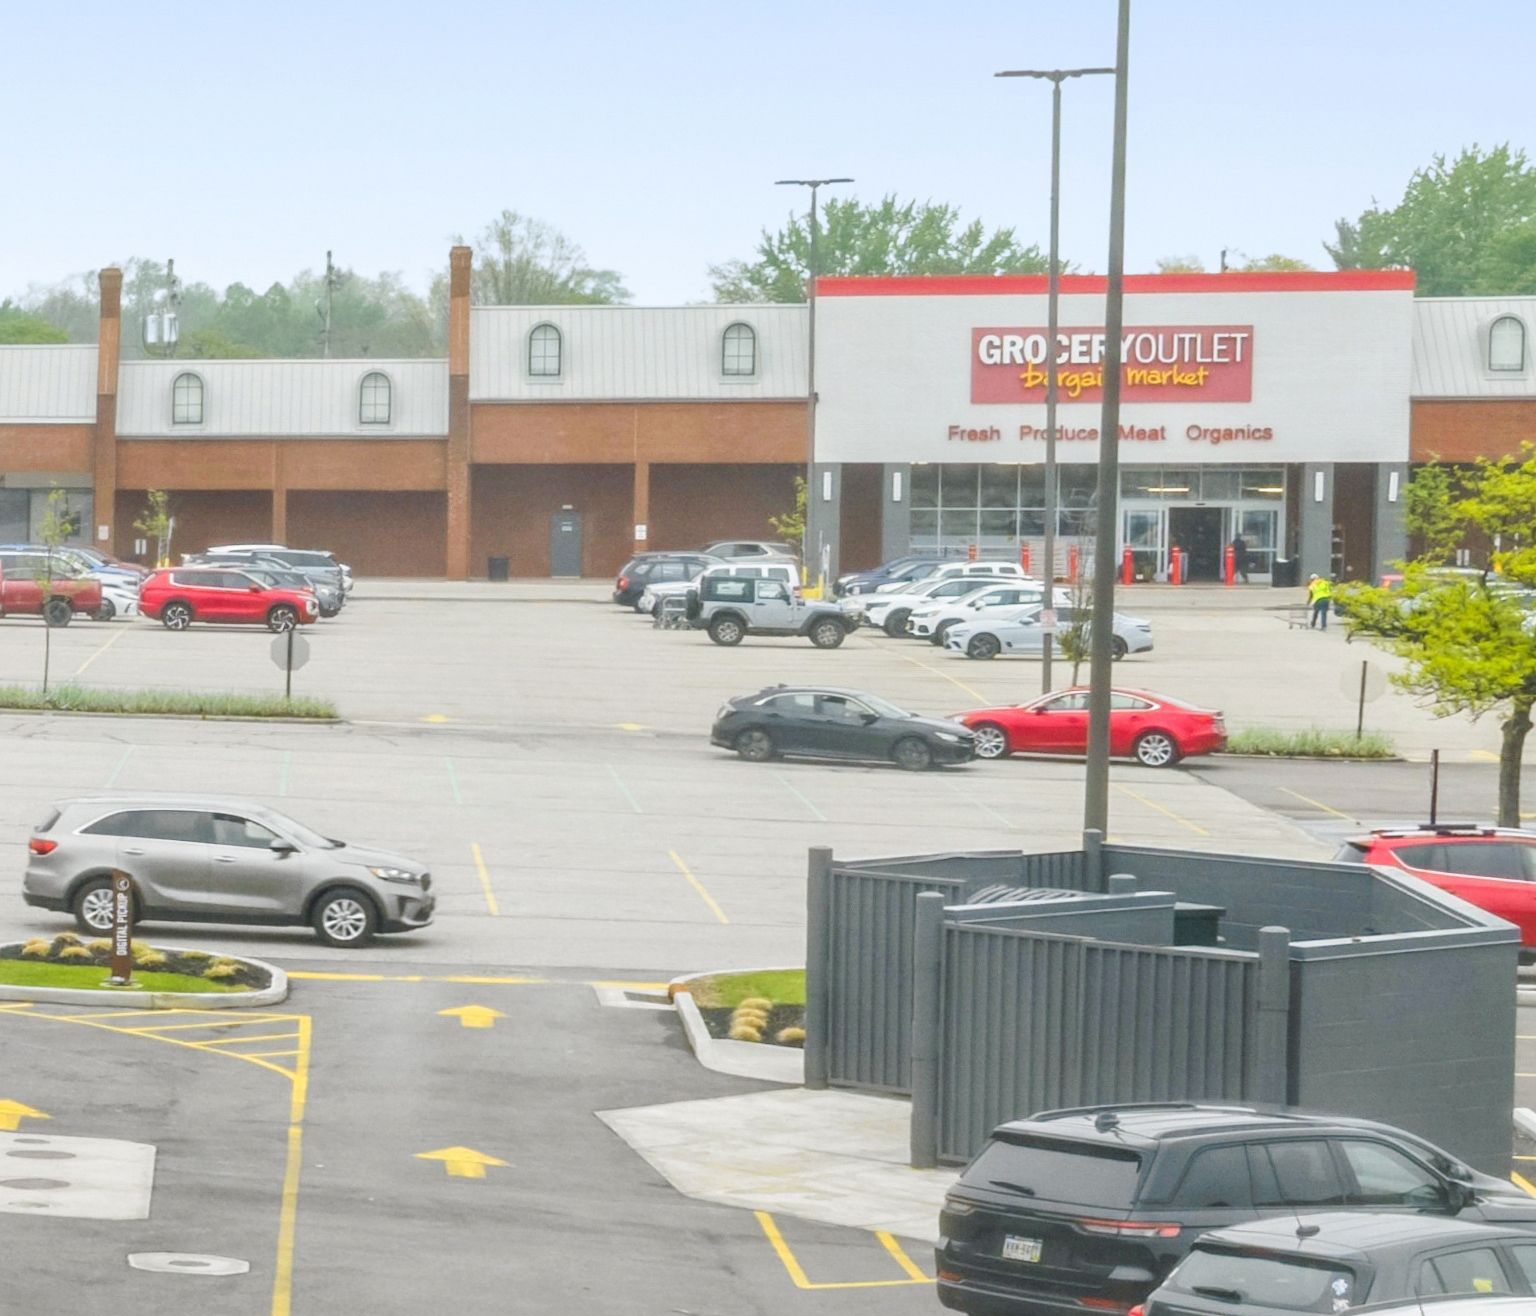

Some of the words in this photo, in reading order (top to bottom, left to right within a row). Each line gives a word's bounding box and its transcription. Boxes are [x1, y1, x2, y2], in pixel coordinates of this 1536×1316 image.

[1127, 364, 1210, 386] market
[948, 424, 1001, 441] Fresh
[1019, 424, 1098, 441] Produce
[1118, 424, 1166, 441] Meat
[1186, 423, 1273, 444] Organics
